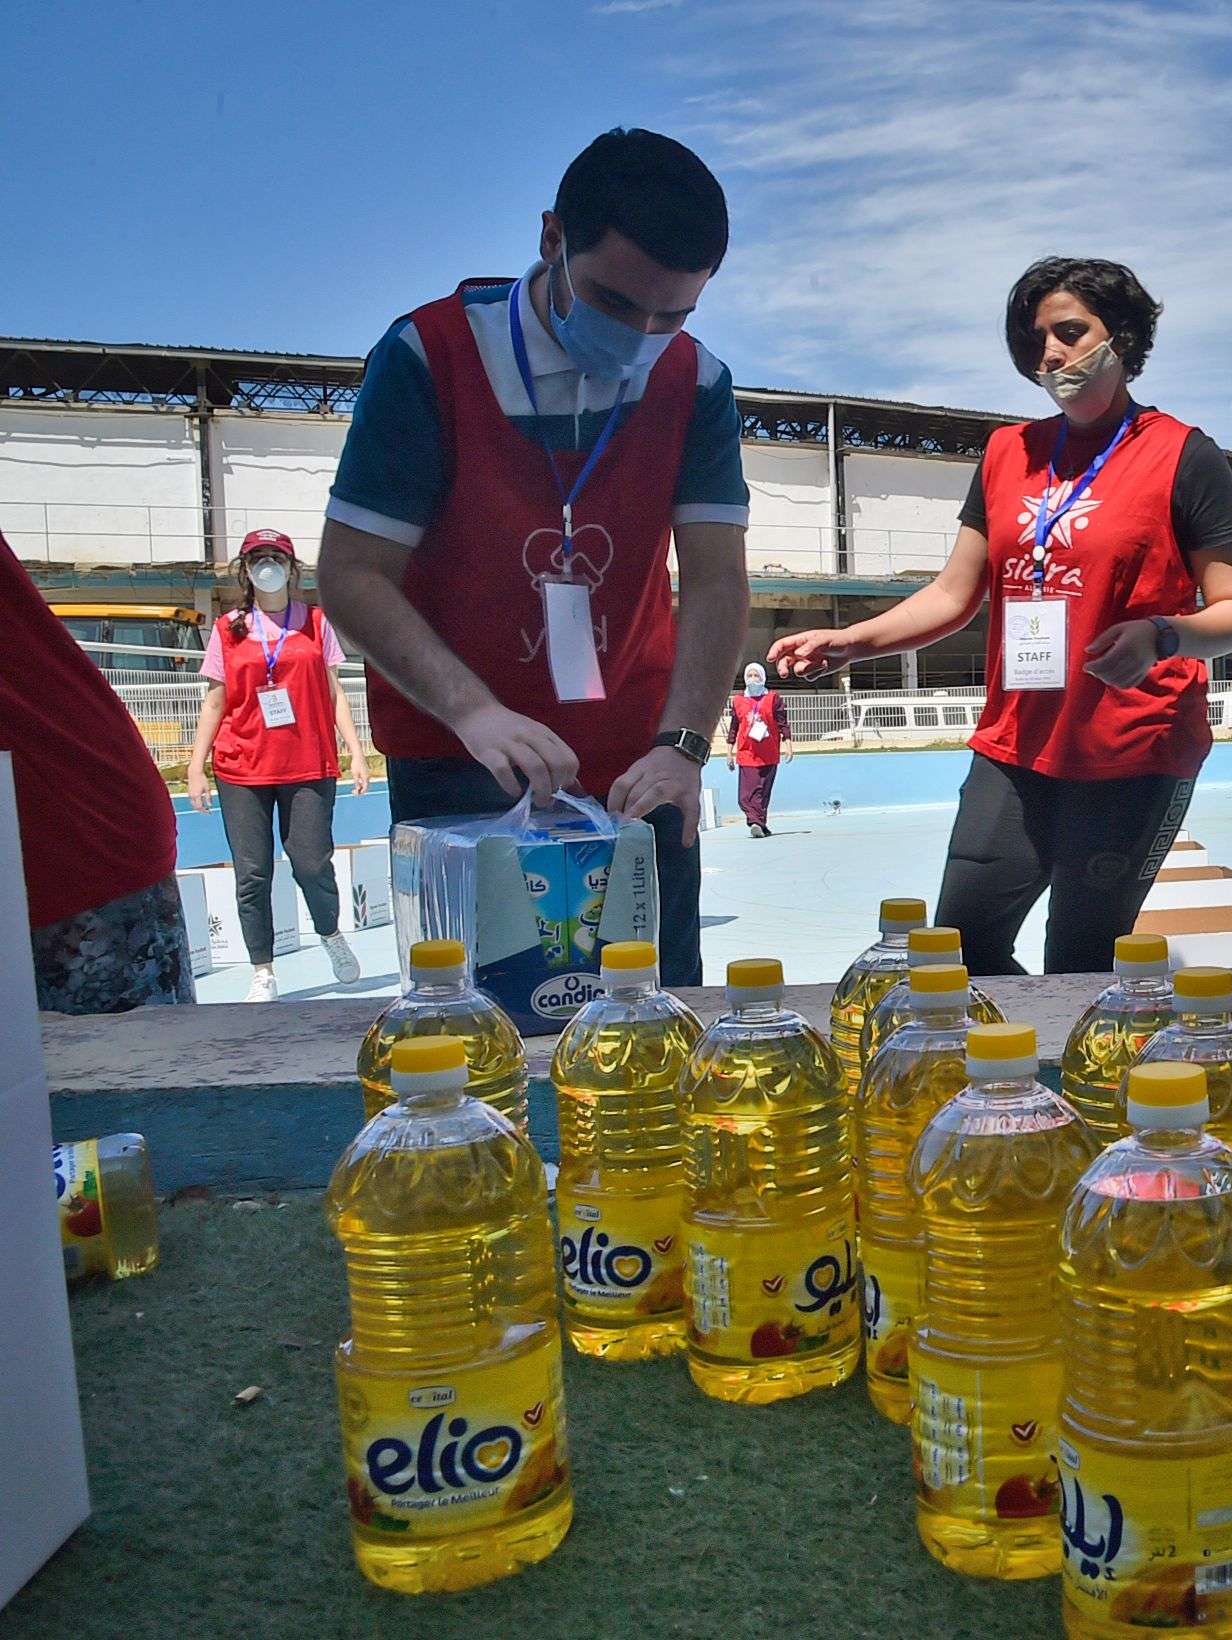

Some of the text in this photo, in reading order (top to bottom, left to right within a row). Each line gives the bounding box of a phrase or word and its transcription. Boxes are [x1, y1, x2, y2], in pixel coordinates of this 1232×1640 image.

[1017, 652, 1052, 662] STAFF
[636, 901, 646, 911] x
[561, 1226, 652, 1288] elio
[366, 1412, 522, 1494] elio
[451, 1486, 500, 1507] Meilleur
